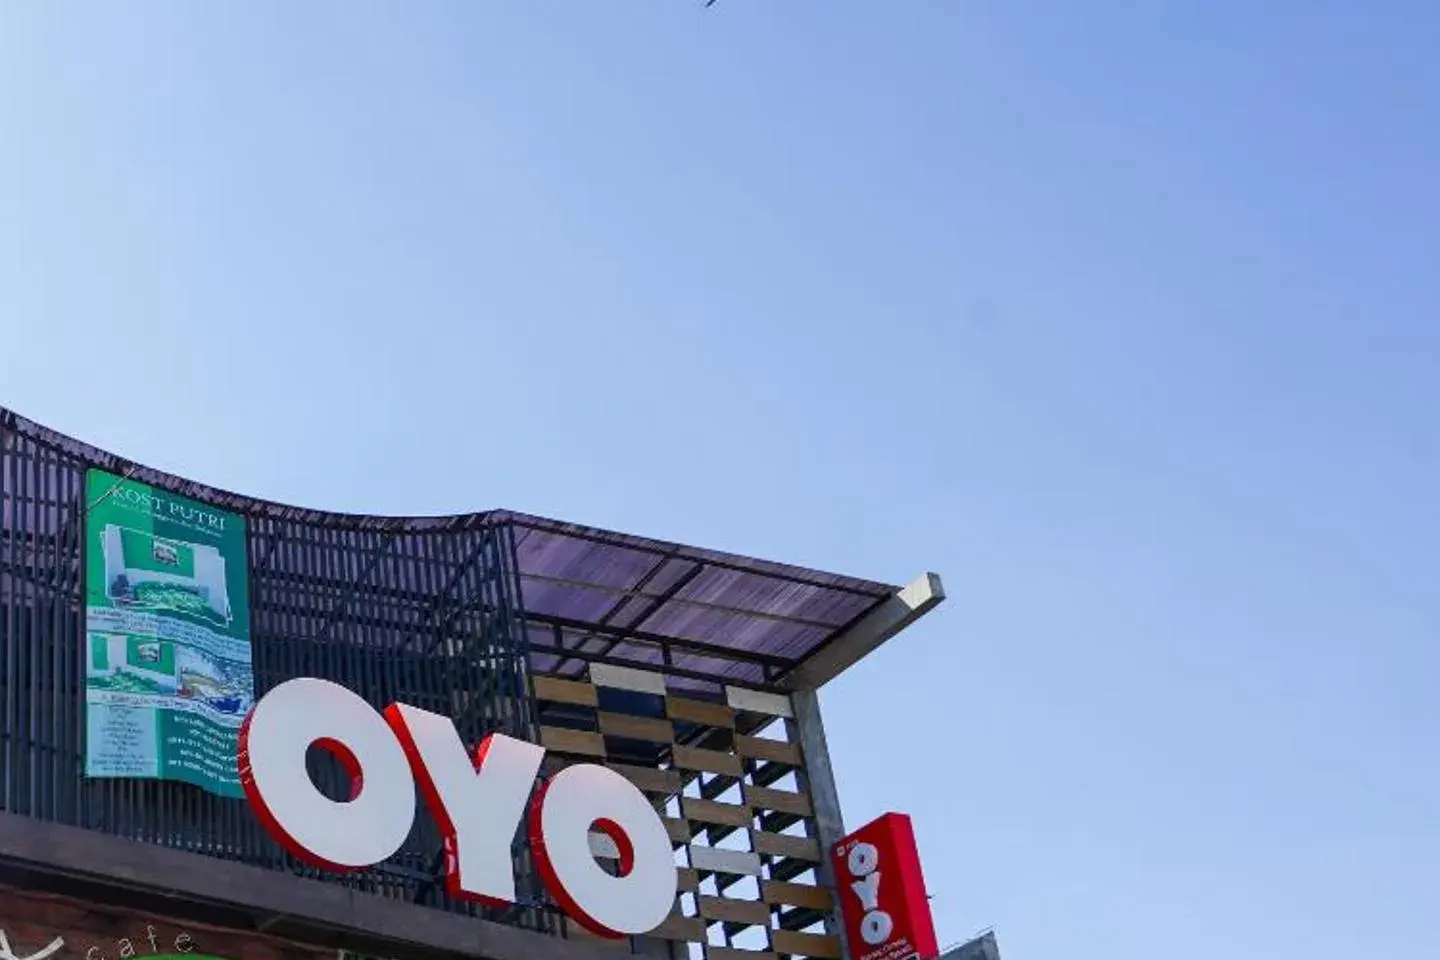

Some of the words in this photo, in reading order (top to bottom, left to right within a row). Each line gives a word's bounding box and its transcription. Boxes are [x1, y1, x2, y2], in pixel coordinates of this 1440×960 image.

[112, 485, 165, 510] KOST
[169, 502, 226, 531] PUTRI
[238, 677, 678, 939] OYO
[848, 842, 893, 945] OYO
